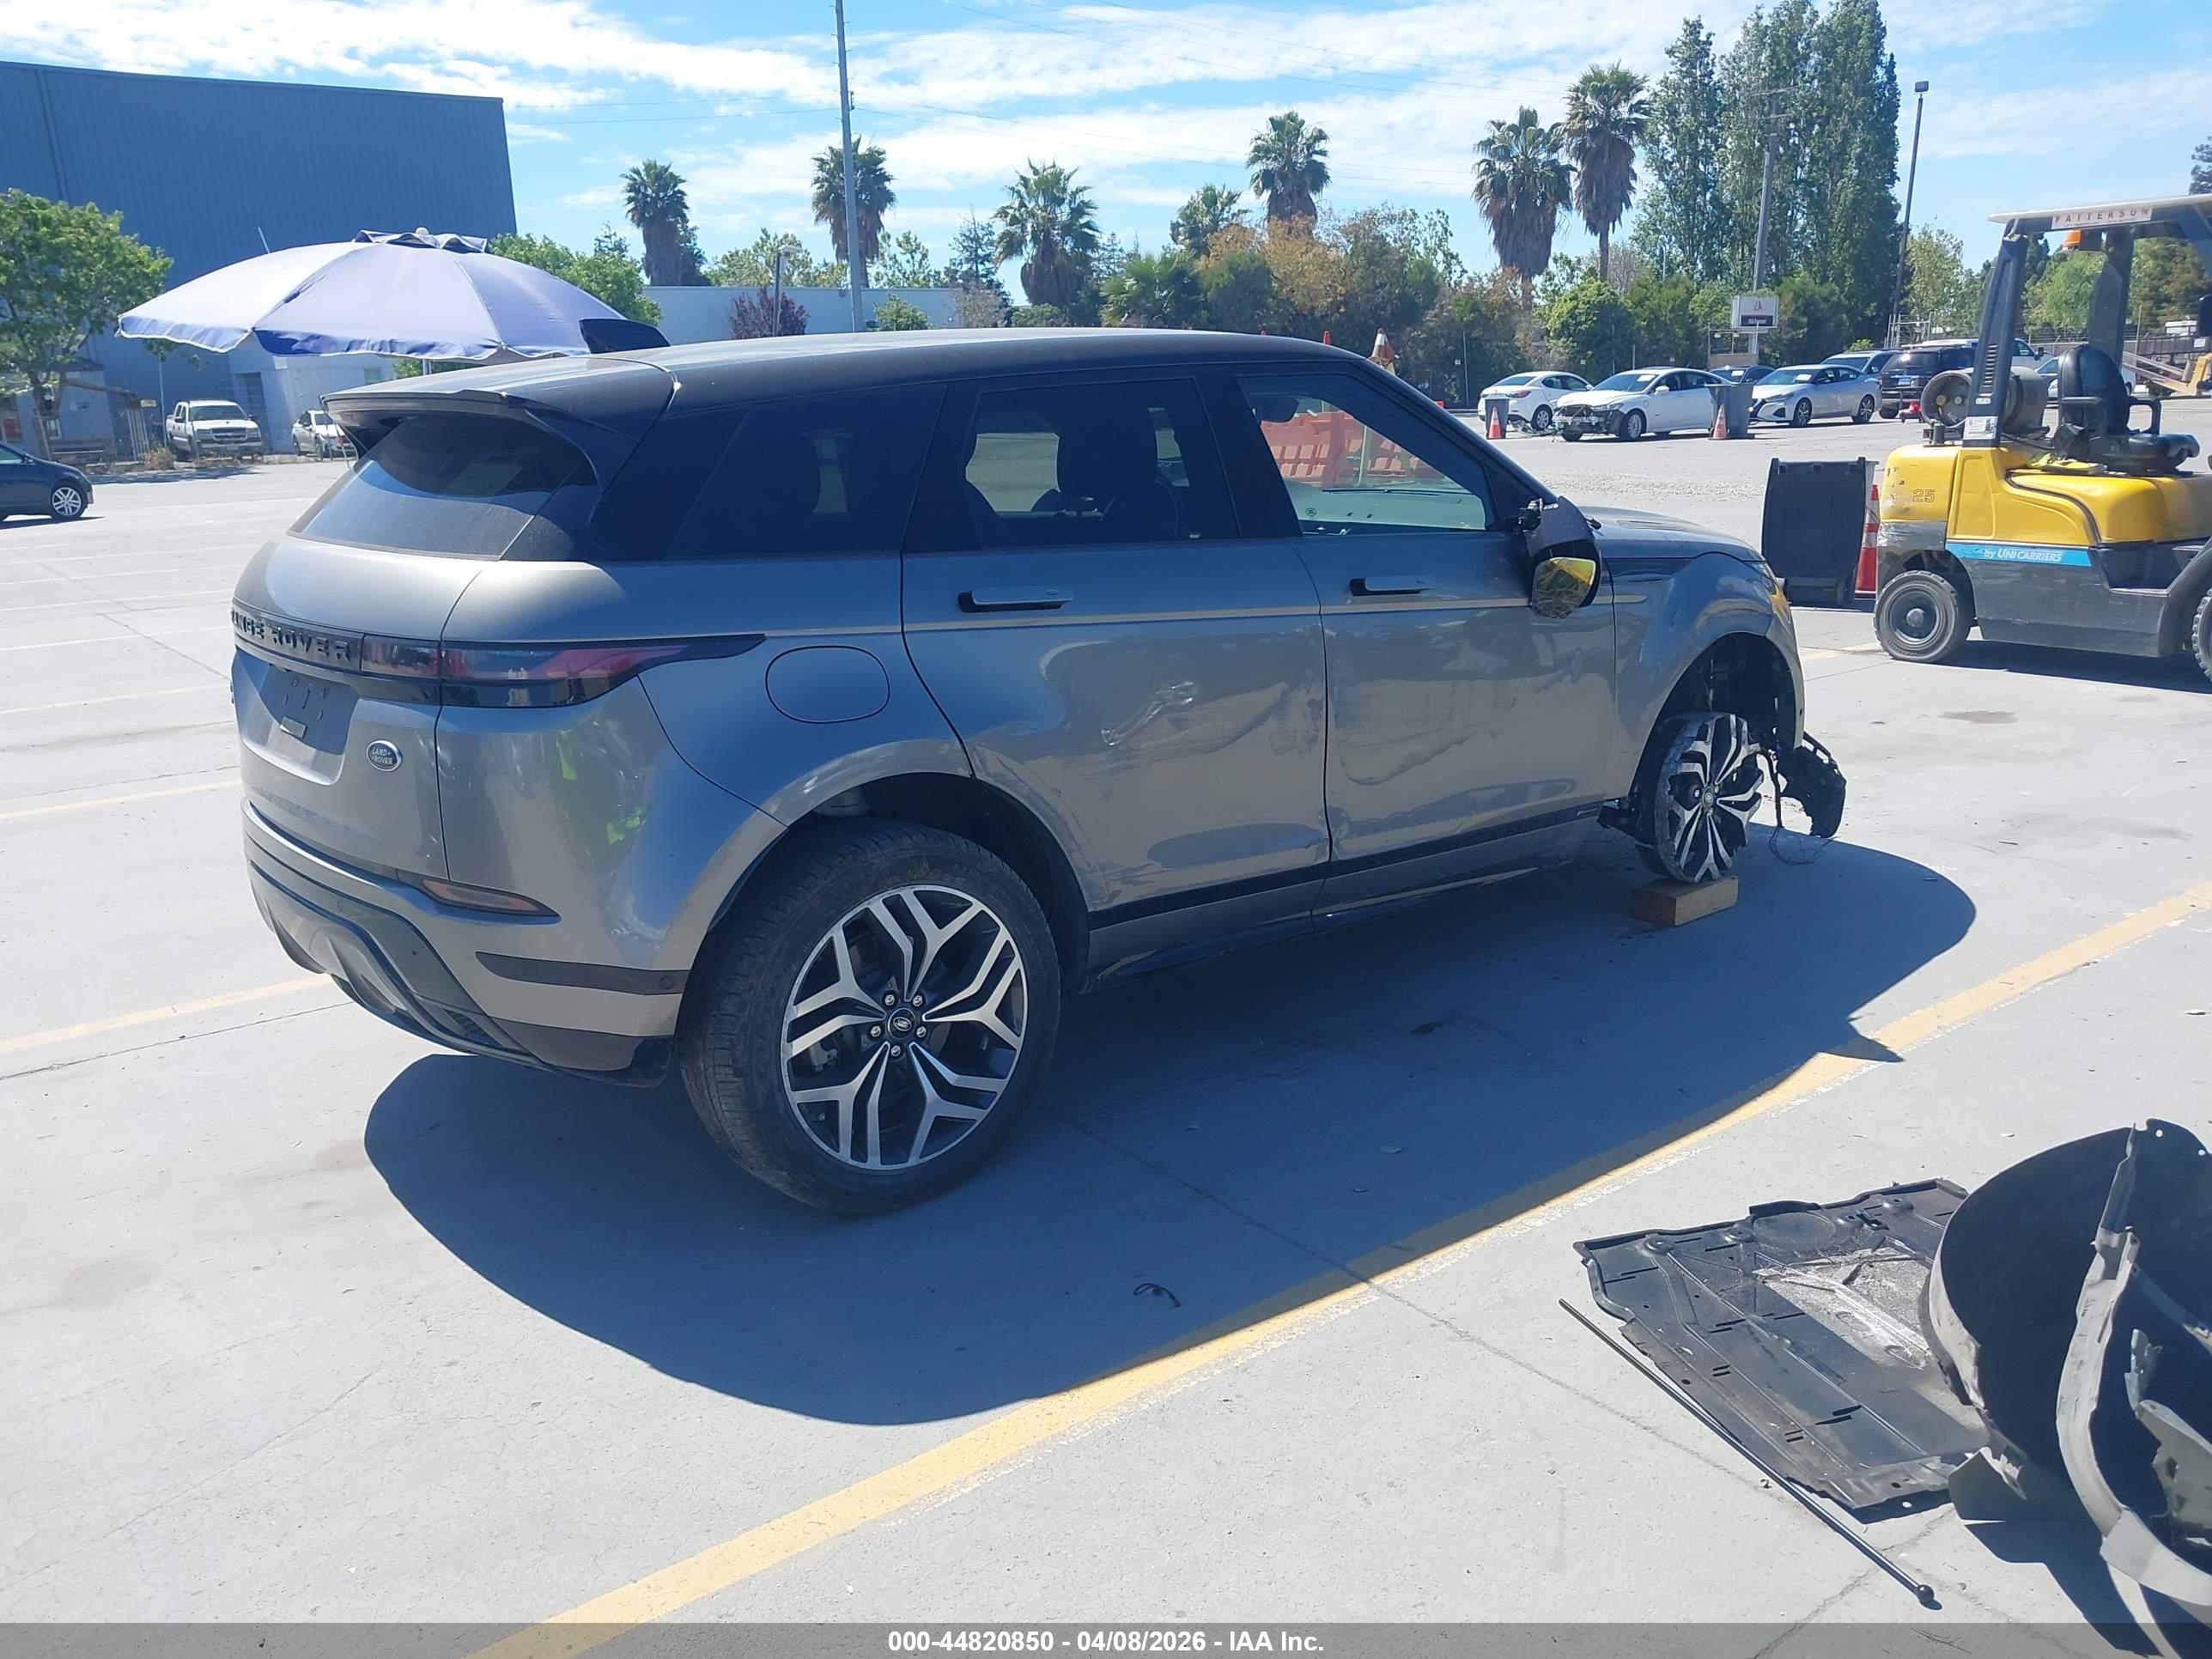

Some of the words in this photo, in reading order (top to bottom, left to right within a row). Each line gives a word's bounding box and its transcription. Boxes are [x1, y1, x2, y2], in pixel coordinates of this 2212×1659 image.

[2055, 208, 2148, 224] PATTERSON
[1912, 489, 1936, 503] 25
[1984, 549, 1996, 559] by
[1998, 549, 2063, 562] UNICARRIERS
[231, 606, 264, 640] ANGE
[270, 623, 350, 661] ROVER
